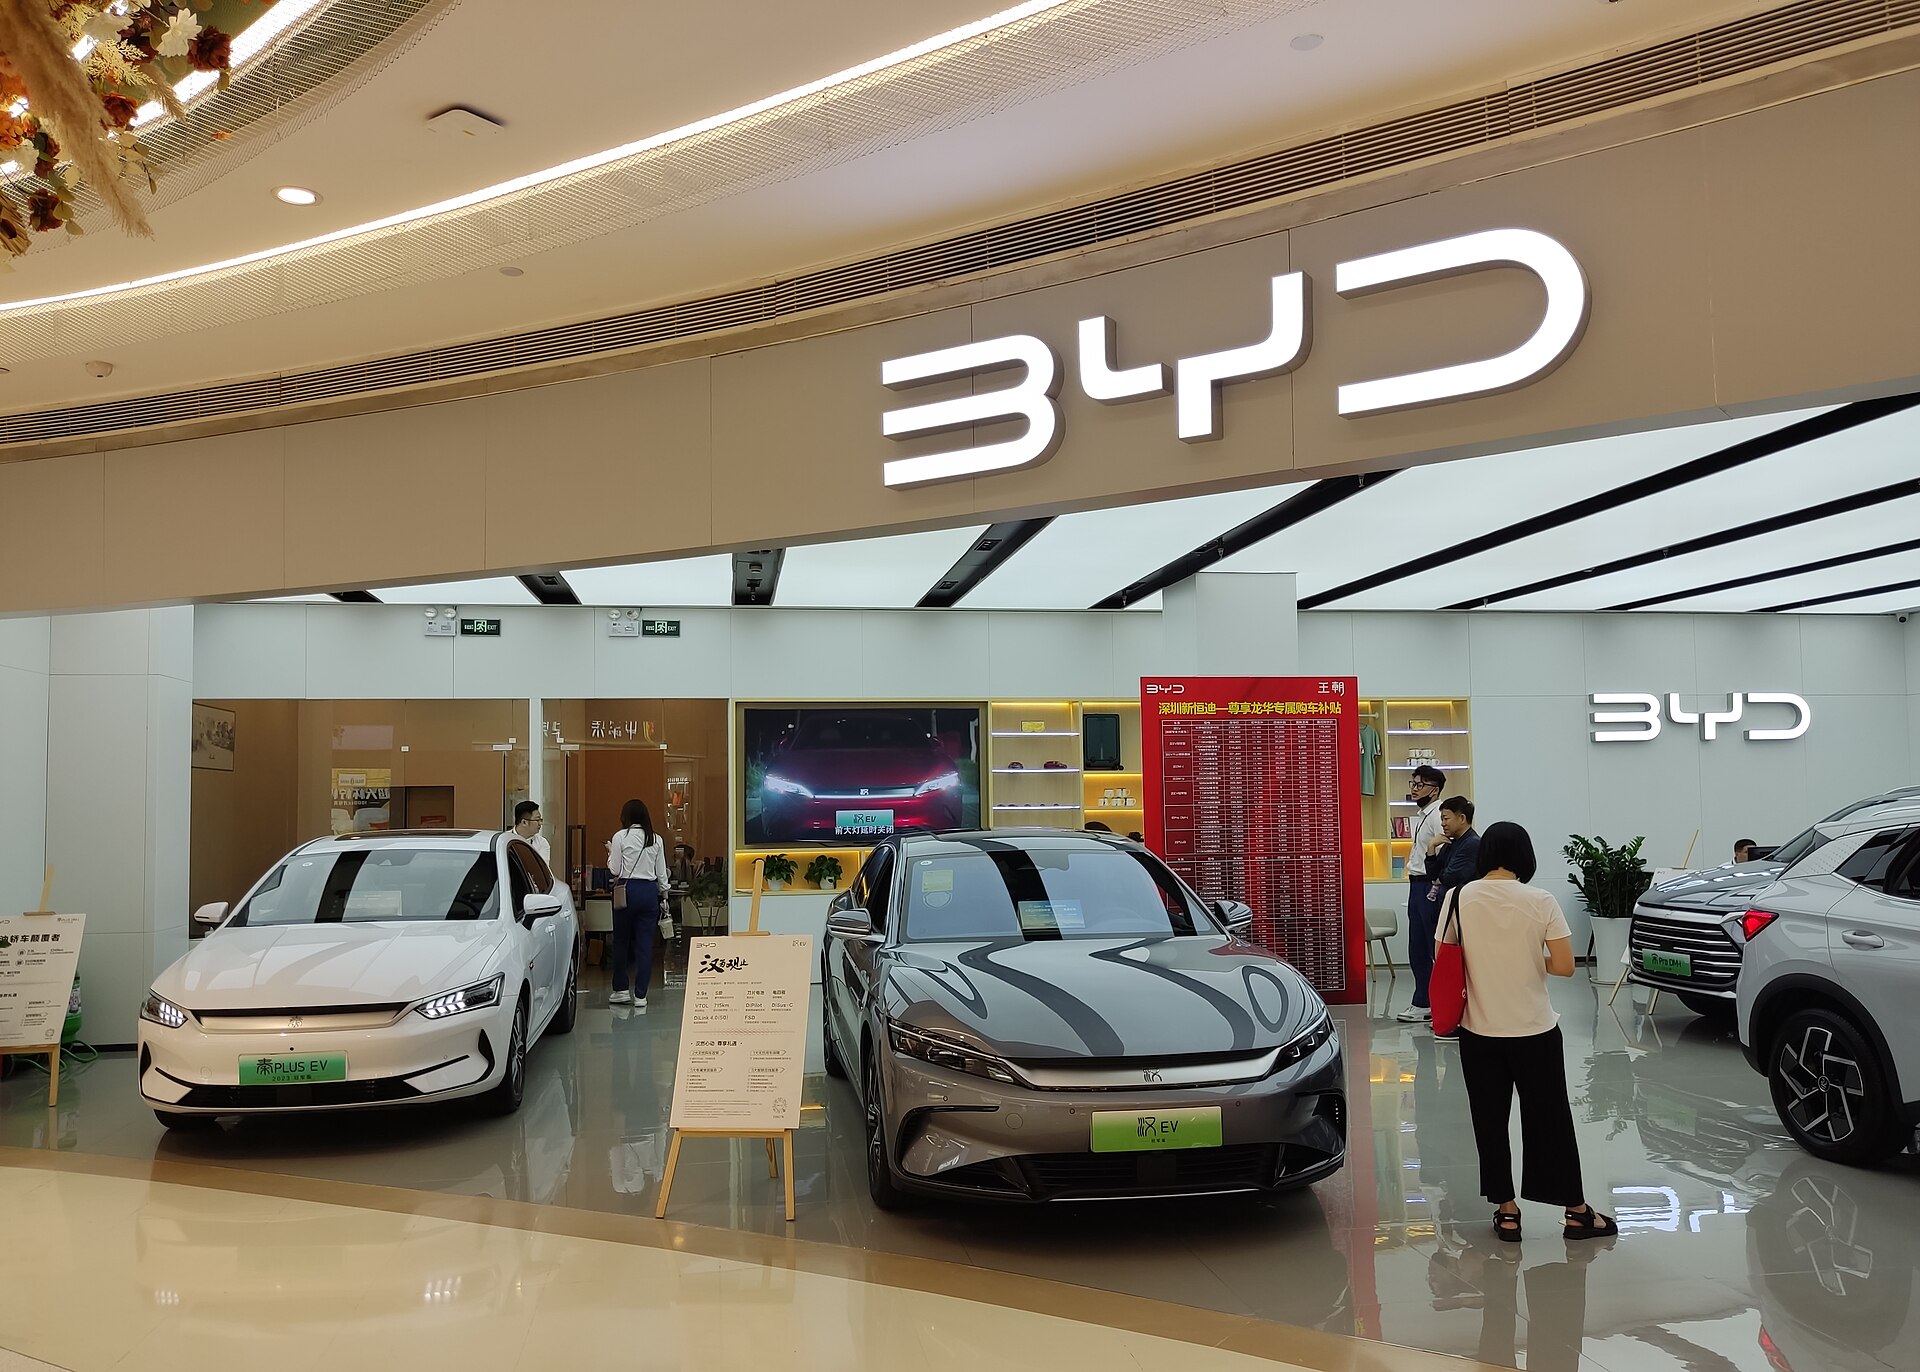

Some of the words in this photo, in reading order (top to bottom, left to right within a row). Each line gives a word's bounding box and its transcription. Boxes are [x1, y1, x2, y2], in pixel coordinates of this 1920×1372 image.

[882, 227, 1591, 490] BYD
[1146, 684, 1185, 694] BYD
[1318, 681, 1345, 696] 王朝
[1589, 692, 1812, 742] BYD
[835, 825, 894, 835] 前大灯延时关闭
[310, 1060, 328, 1072] EV
[1160, 1120, 1179, 1133] EV
